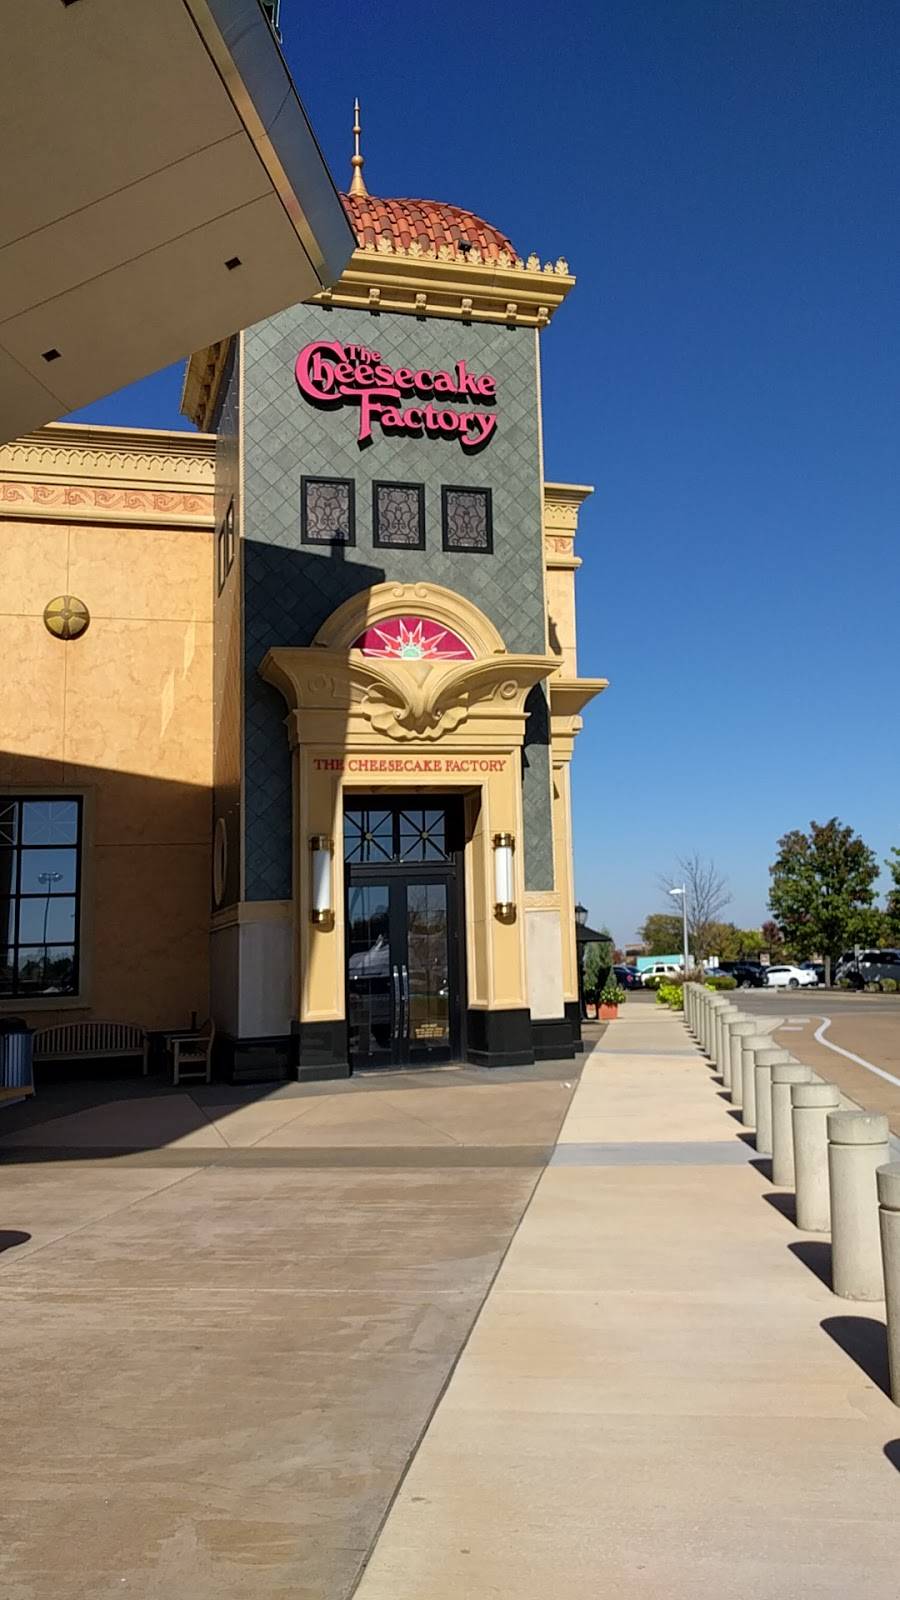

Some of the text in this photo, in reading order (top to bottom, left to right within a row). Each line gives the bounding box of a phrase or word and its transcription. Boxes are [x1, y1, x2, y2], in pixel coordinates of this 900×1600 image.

[295, 340, 497, 400] Cheesecake
[345, 343, 382, 362] The
[339, 385, 497, 445] Factory
[313, 758, 506, 772] THE CHEESECAKE FACTORY
